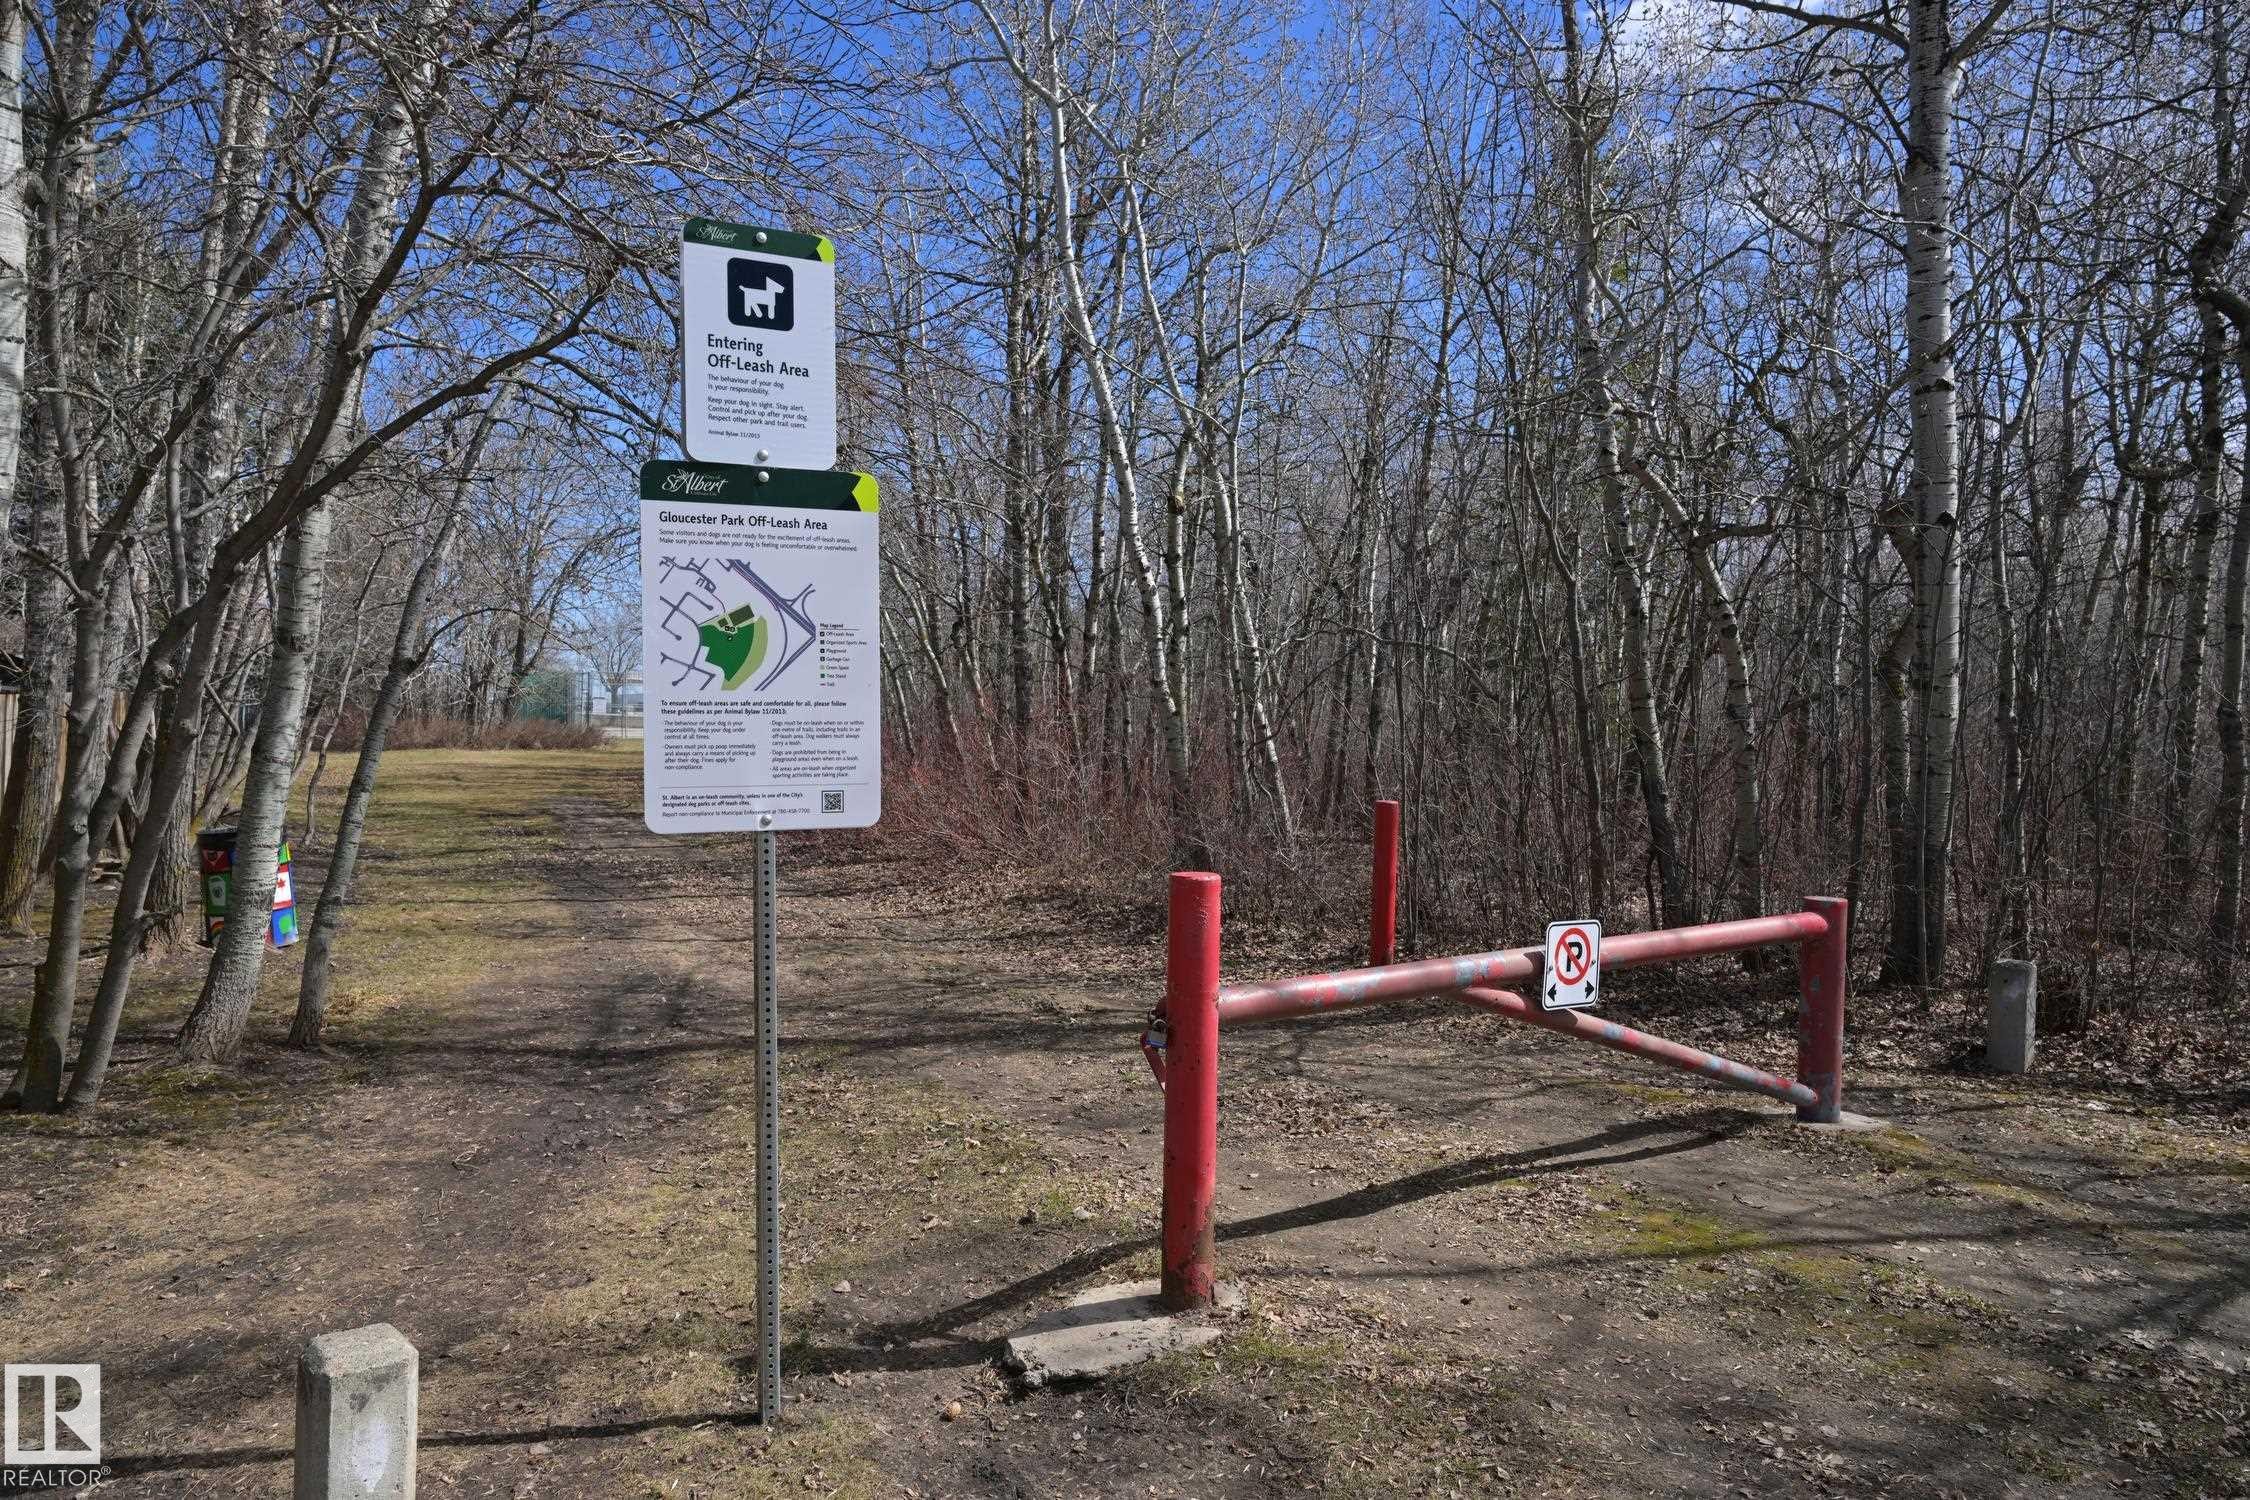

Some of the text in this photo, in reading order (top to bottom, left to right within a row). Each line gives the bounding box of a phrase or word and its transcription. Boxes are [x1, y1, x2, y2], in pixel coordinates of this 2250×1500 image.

[708, 334, 763, 356] Entering
[708, 354, 809, 377] Off-Leash Area
[682, 471, 729, 494] Albert
[659, 511, 828, 530] Gloucester Park Off-Leash Area
[678, 708, 705, 716] guidelines
[744, 708, 761, 716] Bylaw
[813, 700, 830, 708] please
